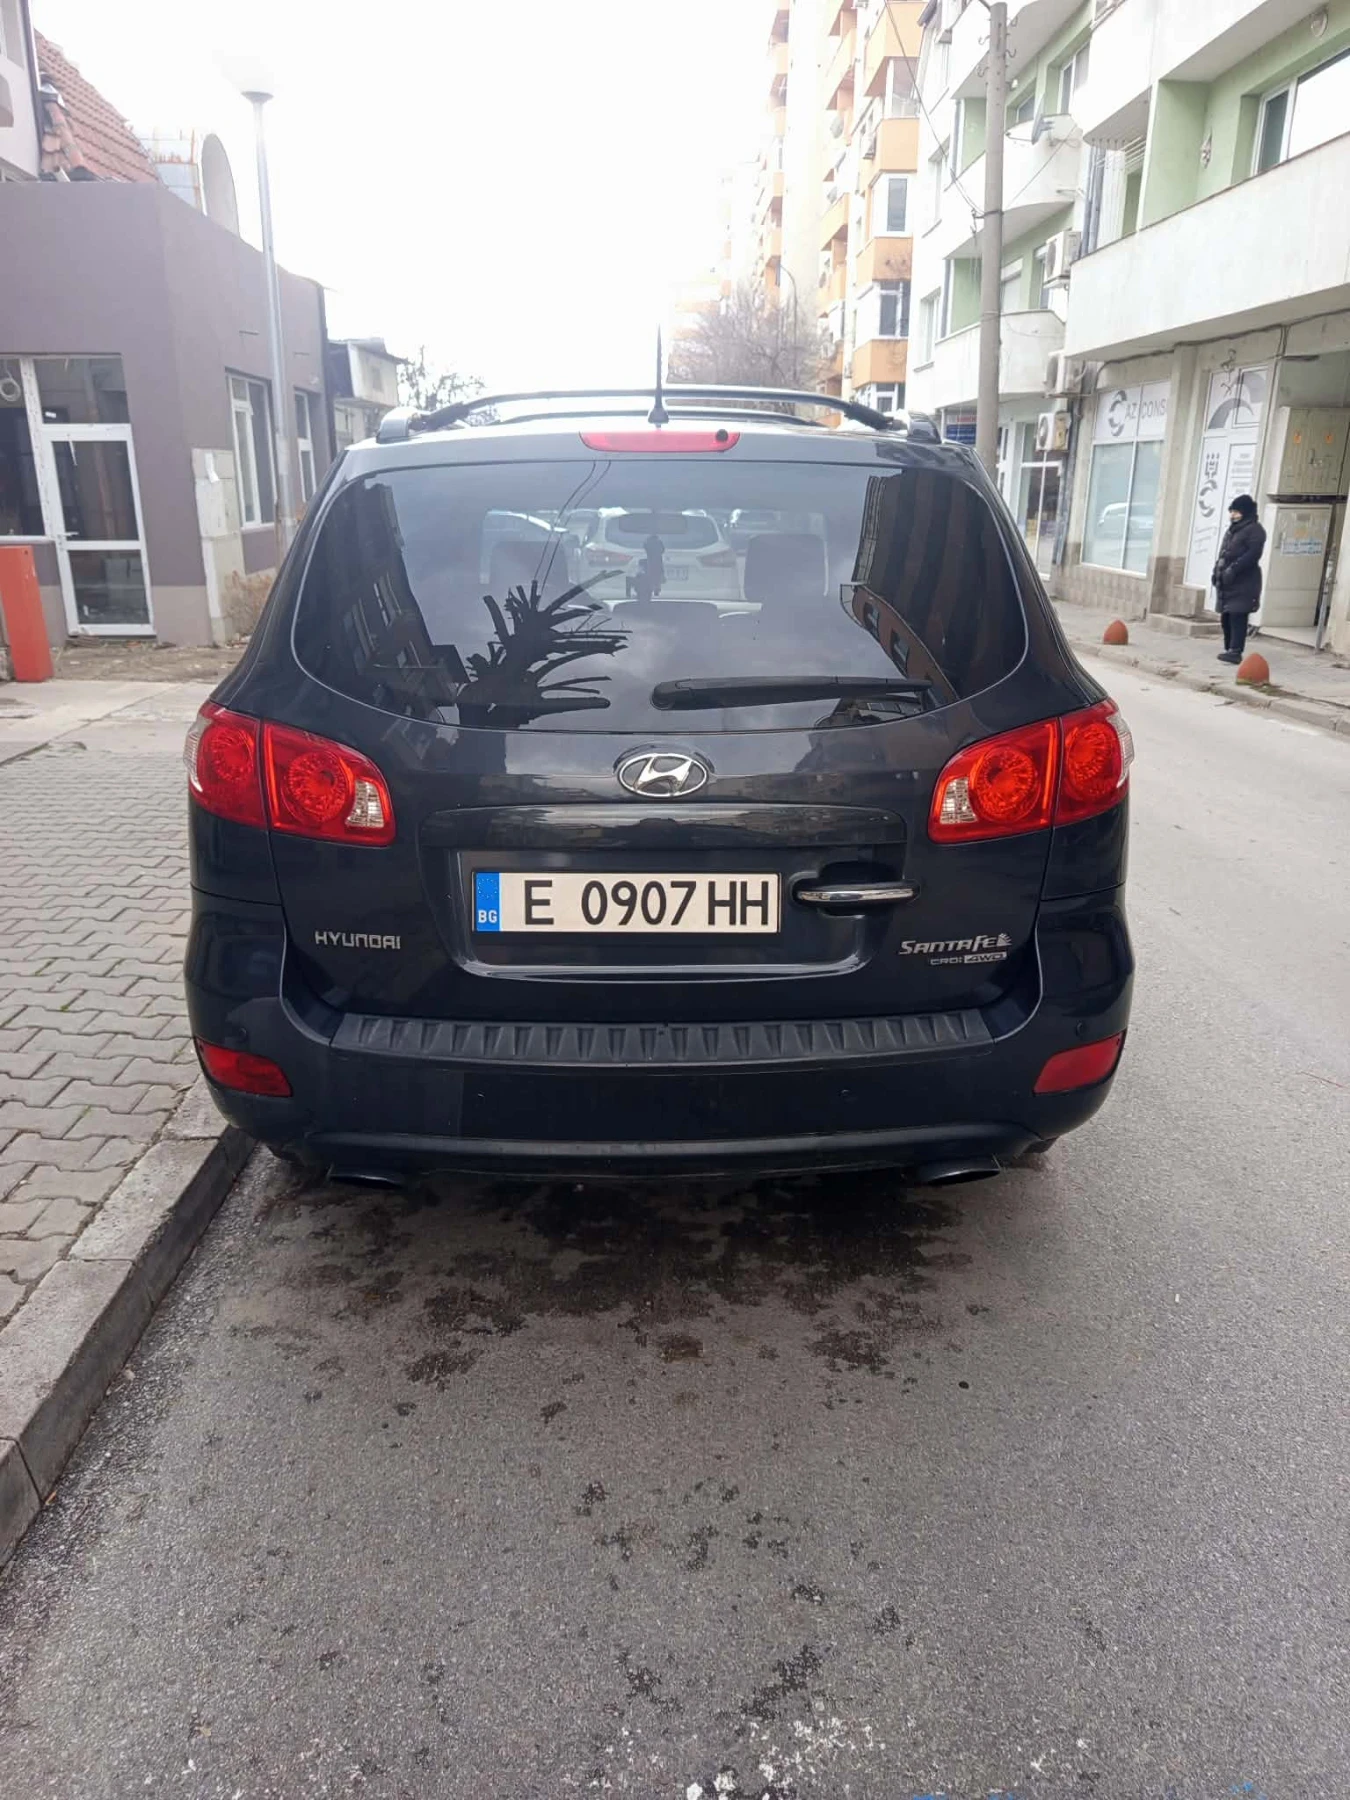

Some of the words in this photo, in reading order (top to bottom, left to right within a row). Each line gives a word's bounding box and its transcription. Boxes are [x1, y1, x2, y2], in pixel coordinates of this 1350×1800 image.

[524, 880, 554, 925] E
[580, 880, 697, 926] 0907
[477, 909, 498, 923] BG
[314, 930, 401, 950] HYUNDAI
